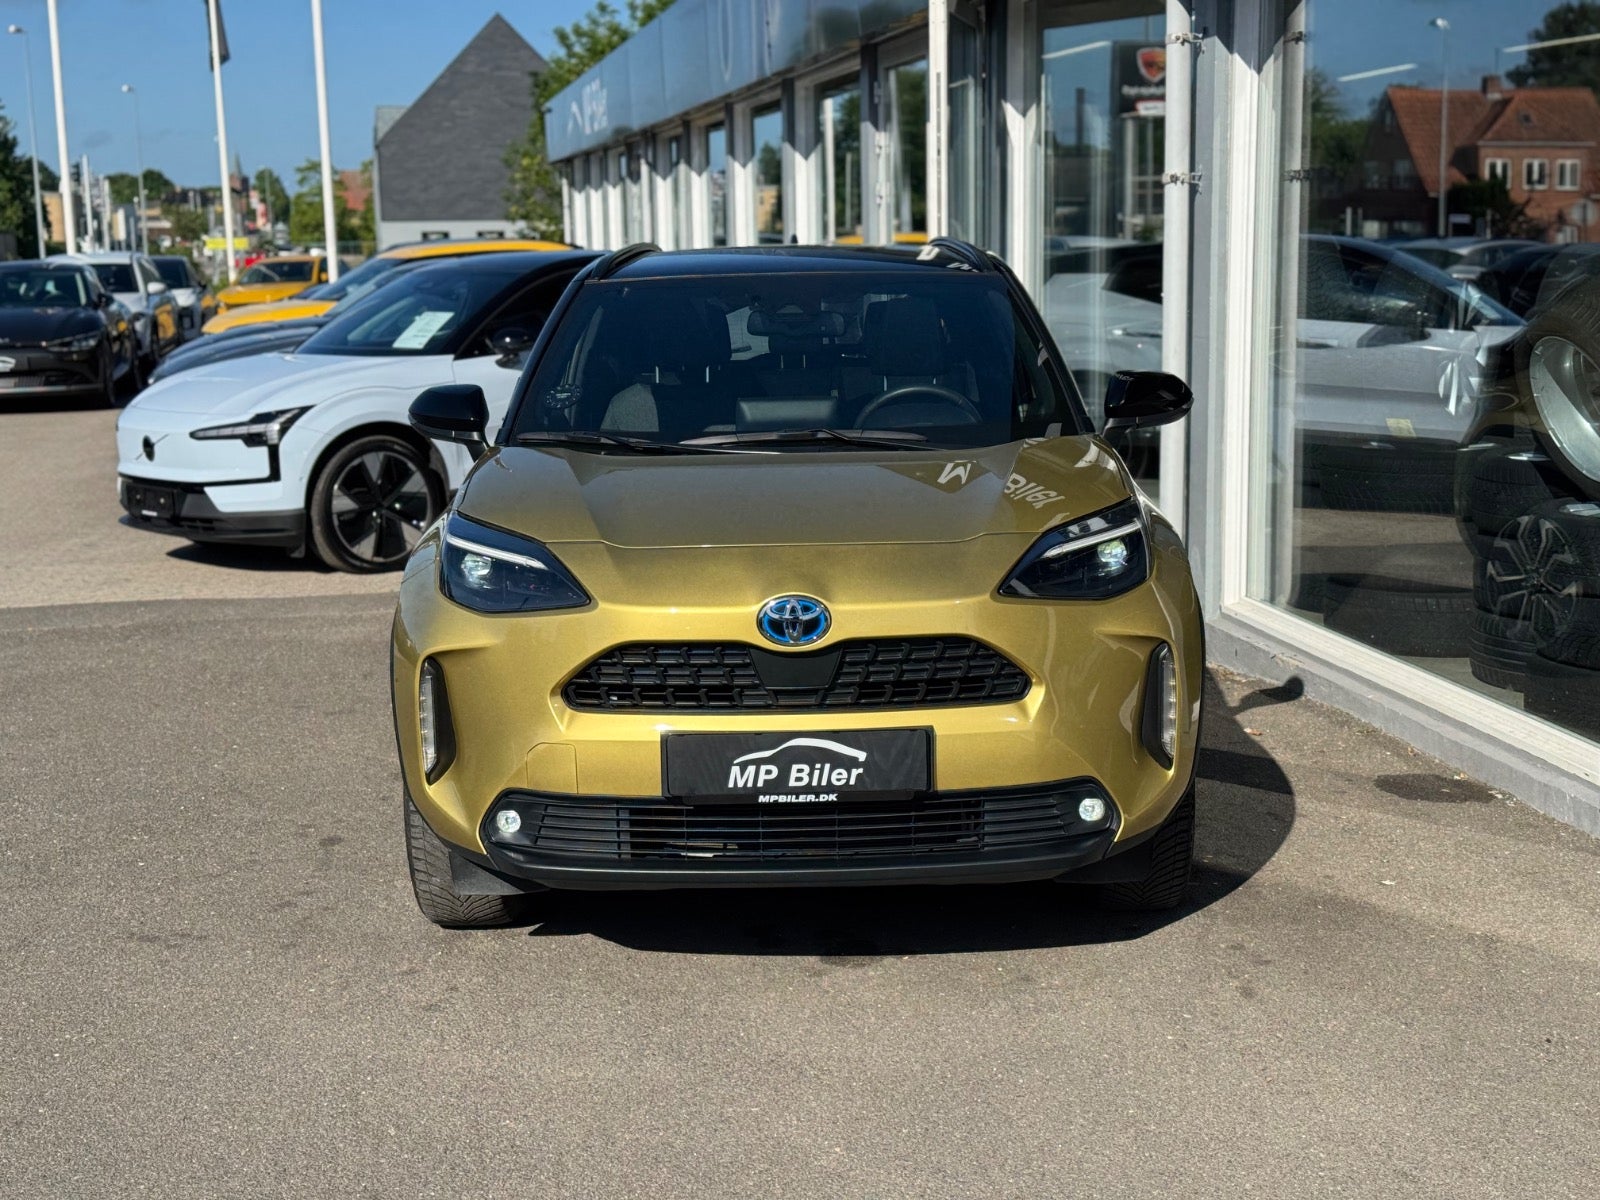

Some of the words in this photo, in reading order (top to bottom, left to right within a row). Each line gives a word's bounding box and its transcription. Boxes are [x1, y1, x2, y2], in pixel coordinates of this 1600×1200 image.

[728, 764, 778, 788] MP
[788, 763, 863, 787] Biler
[758, 793, 838, 803] MPBILER.DK
